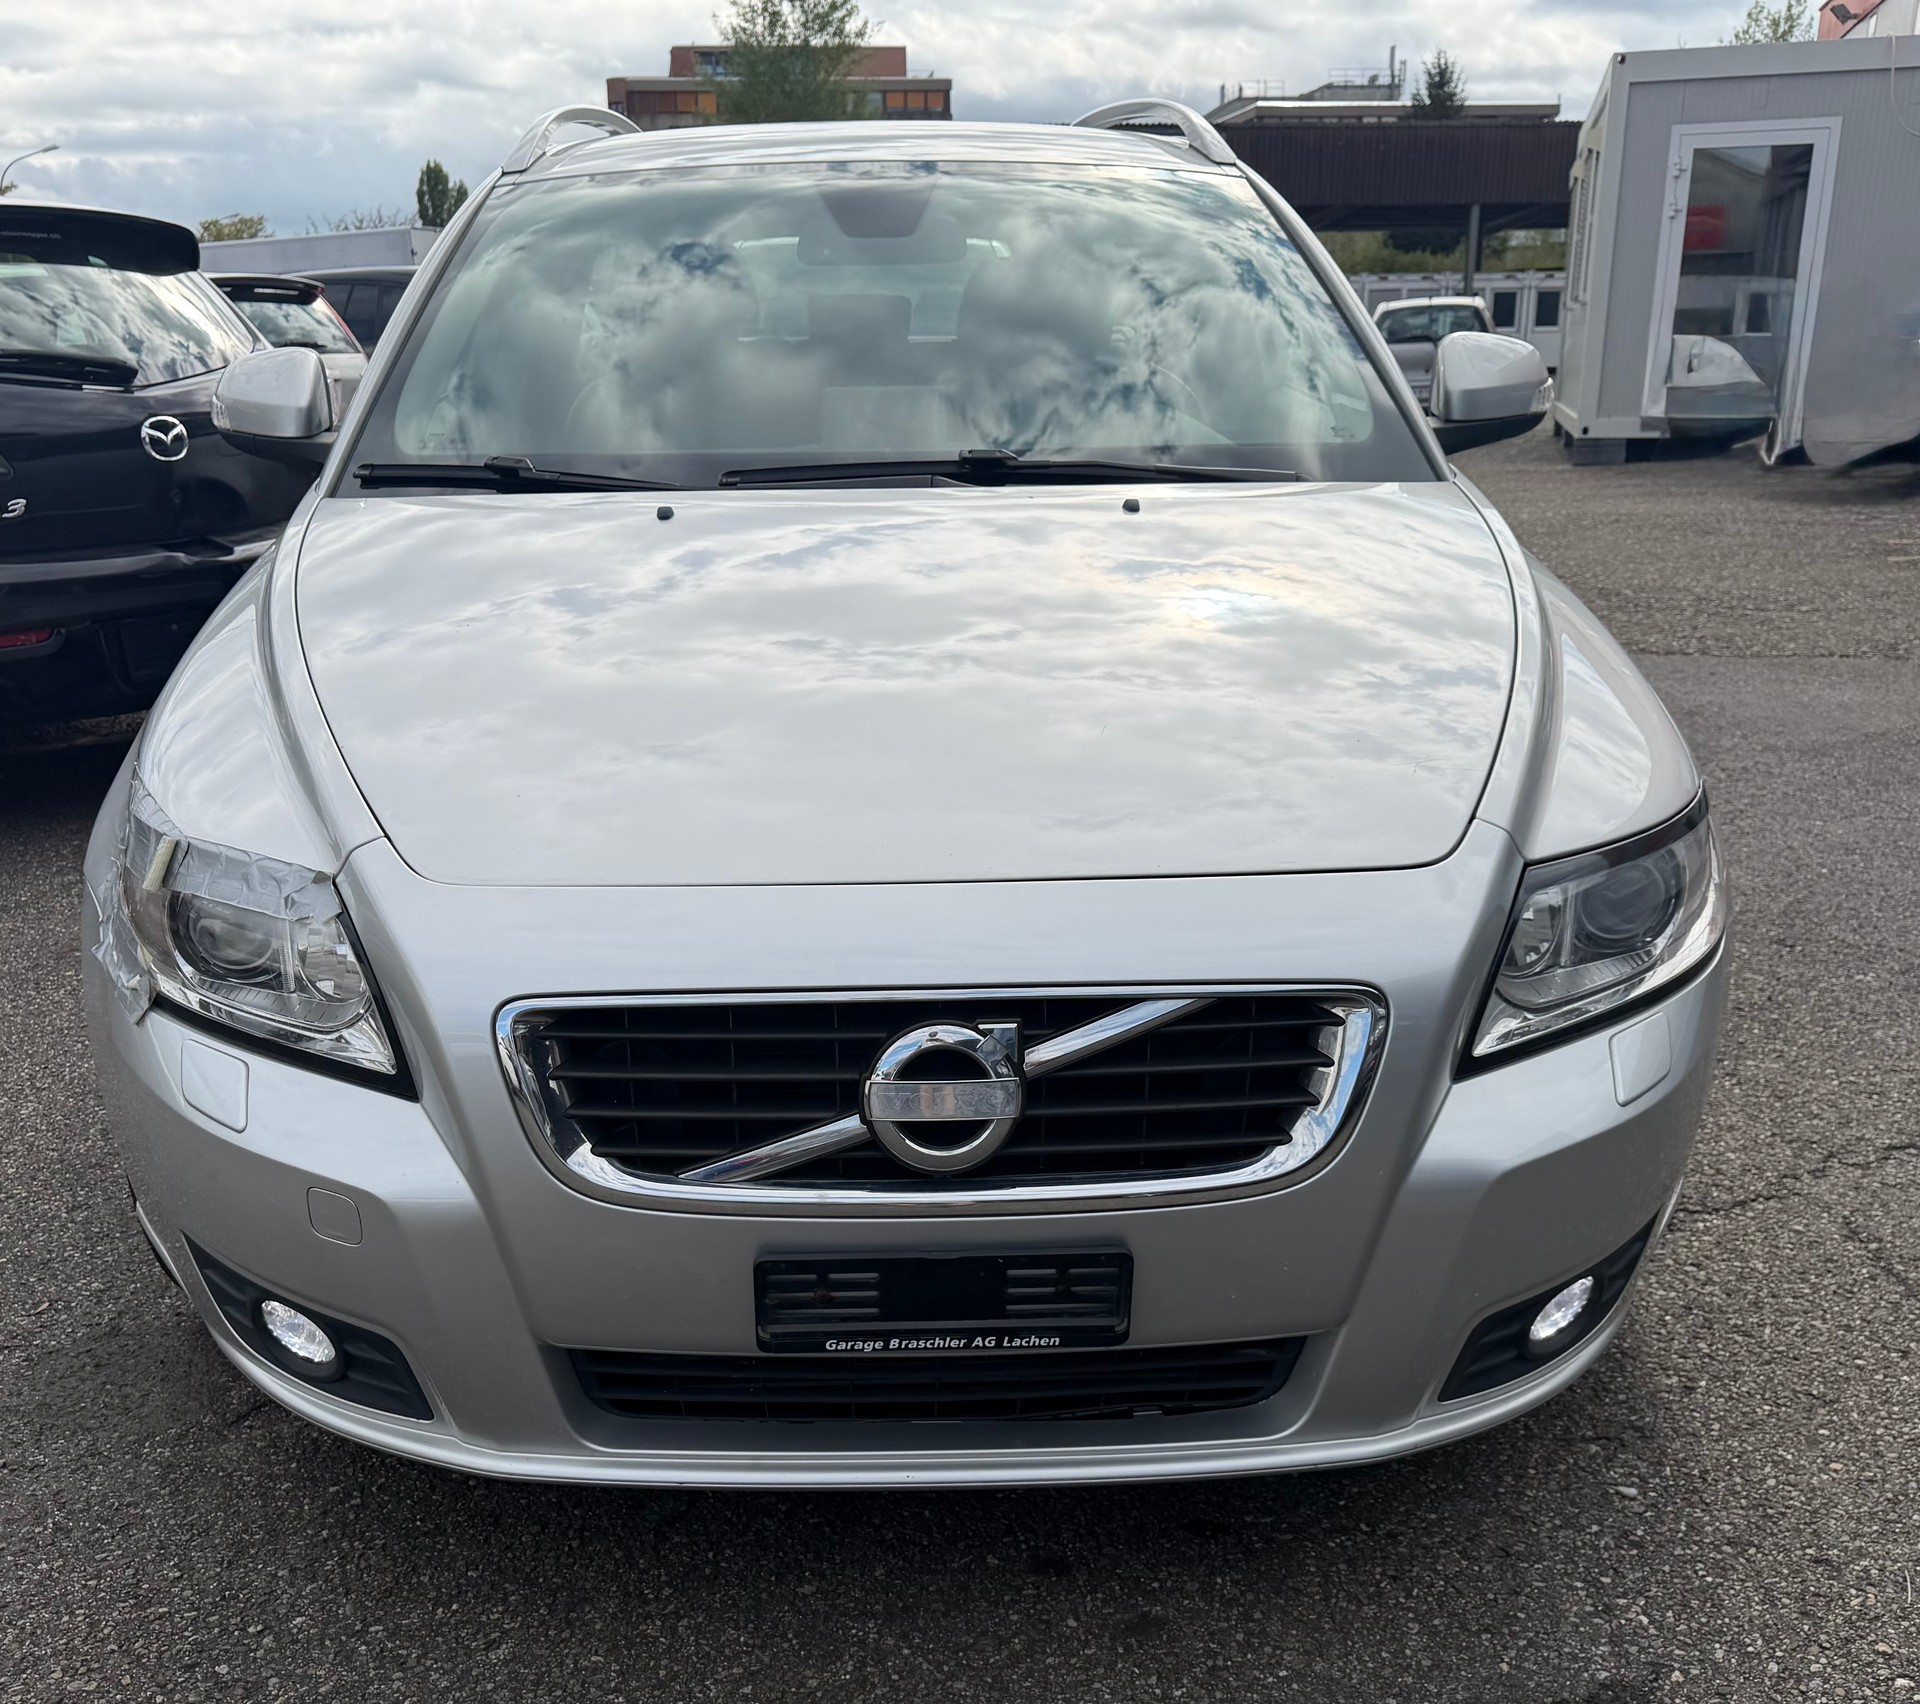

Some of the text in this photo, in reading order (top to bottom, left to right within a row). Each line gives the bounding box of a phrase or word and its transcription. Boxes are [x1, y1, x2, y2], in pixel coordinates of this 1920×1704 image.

[825, 1335, 1060, 1352] Garage Braschler AG Lachen
